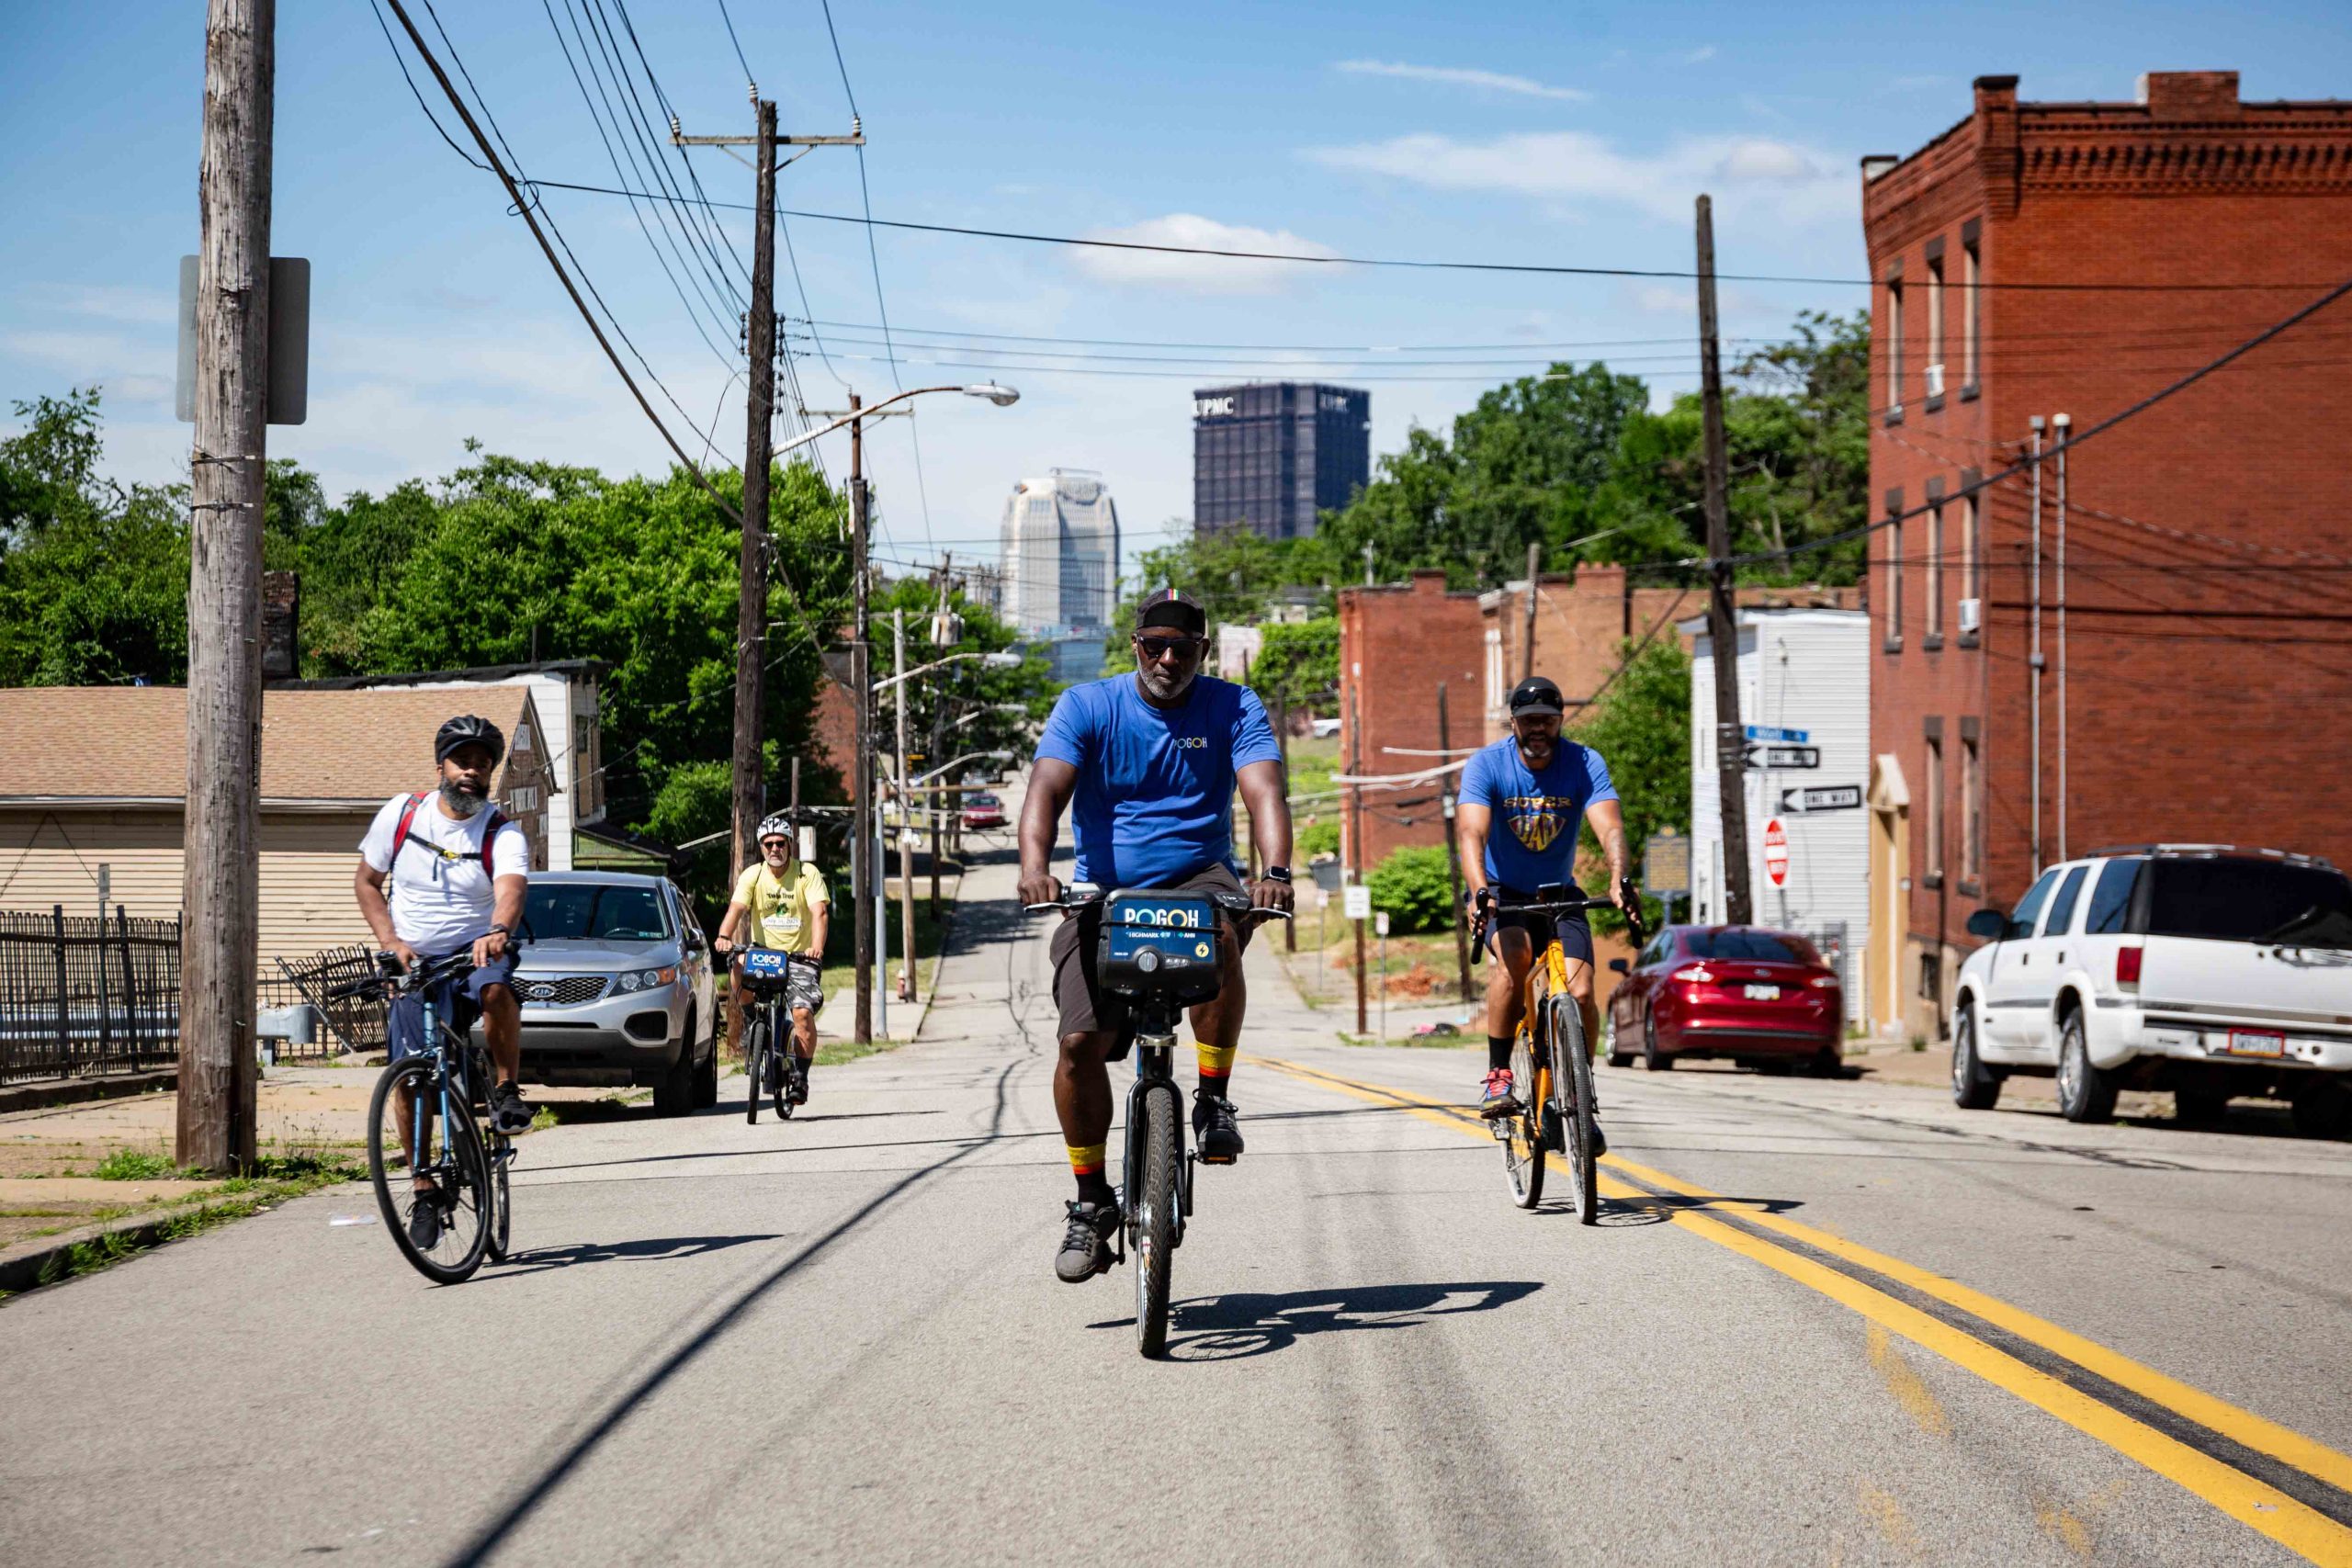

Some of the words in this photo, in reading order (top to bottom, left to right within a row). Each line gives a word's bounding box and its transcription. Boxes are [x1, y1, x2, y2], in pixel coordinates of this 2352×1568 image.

[1192, 397, 1234, 414] UPMC
[1831, 792, 1853, 804] WAY
[1125, 908, 1198, 929] POGOH
[752, 953, 781, 964] POGOH
